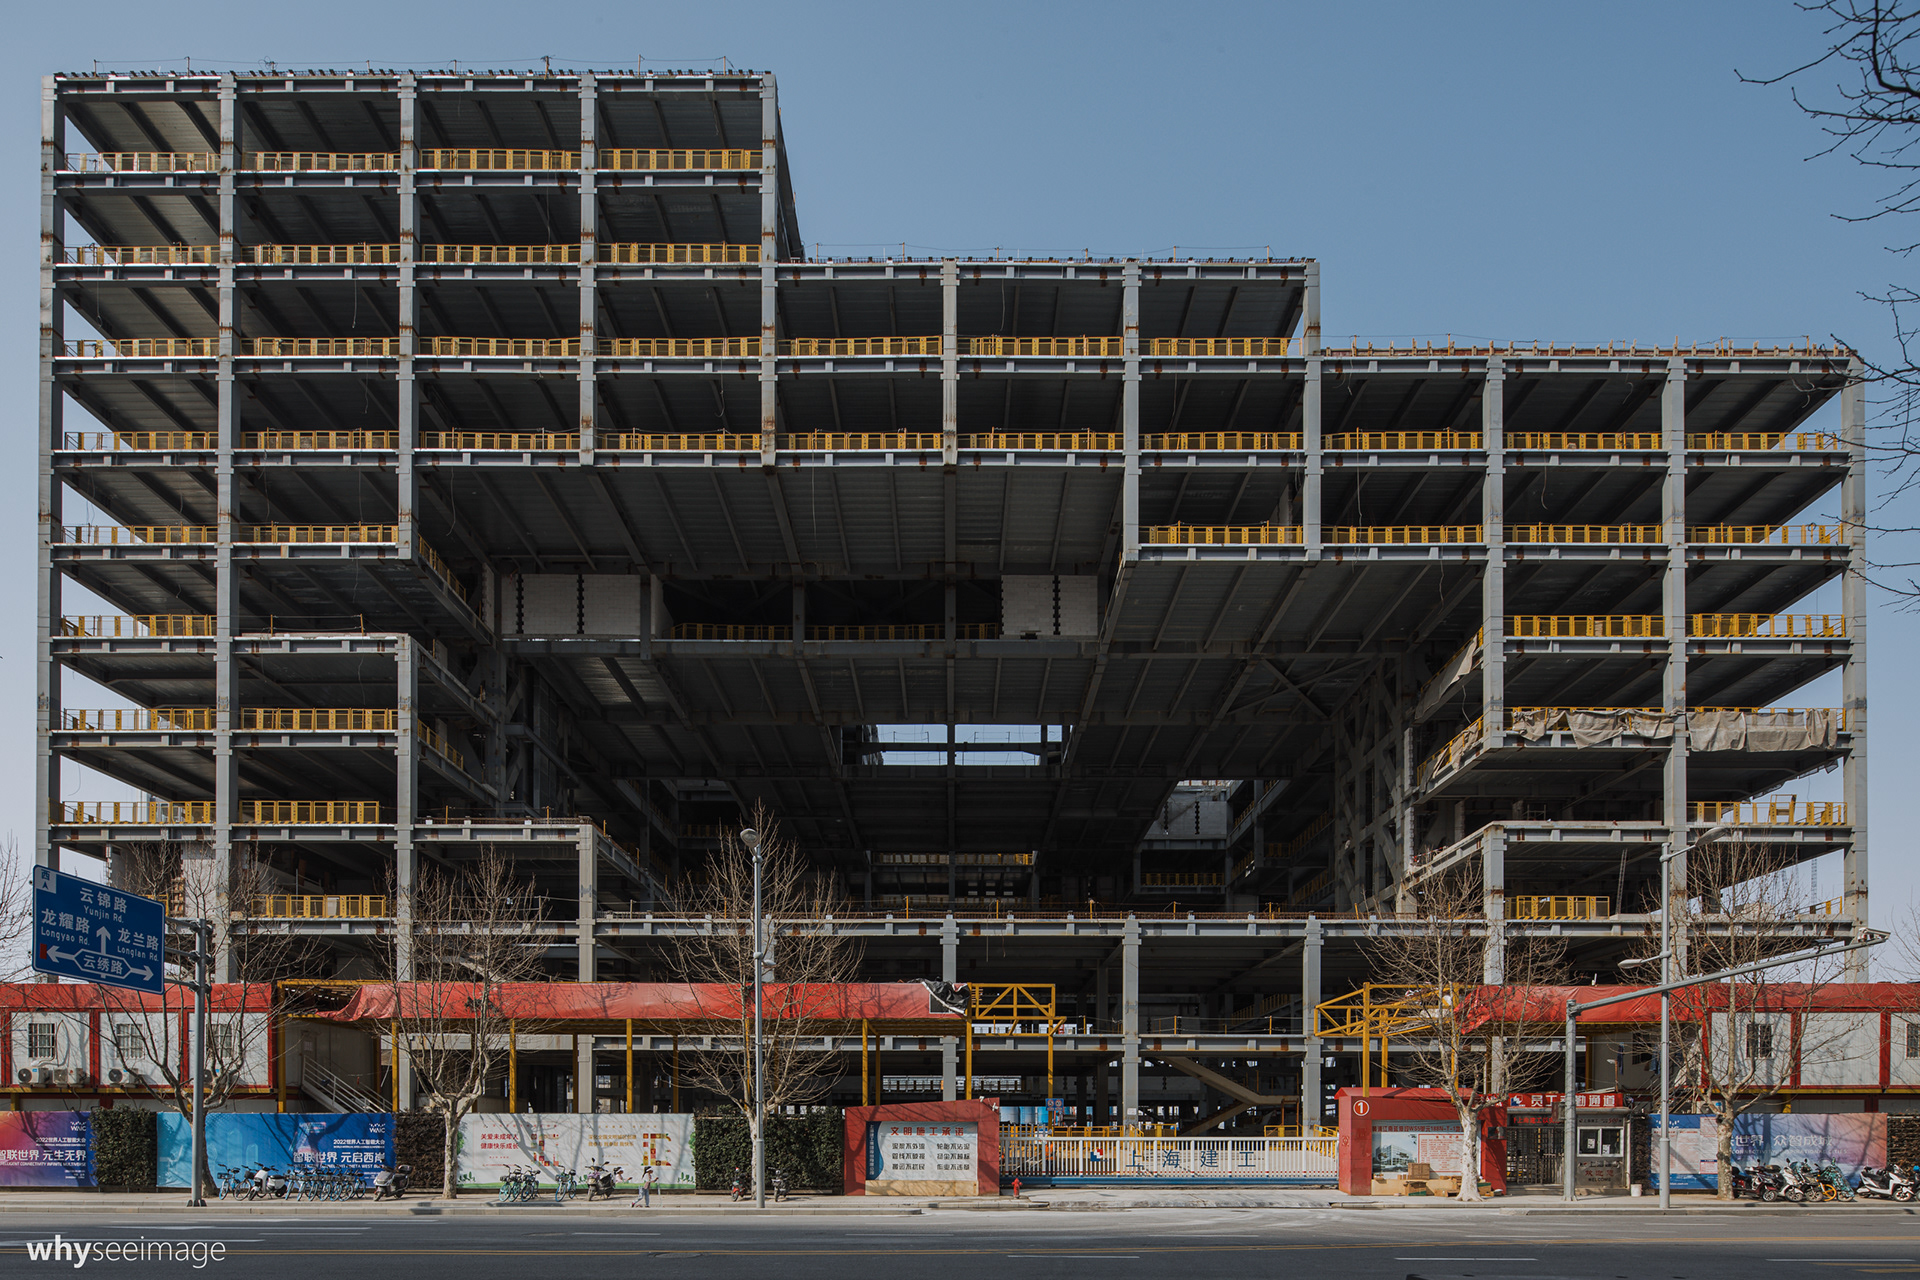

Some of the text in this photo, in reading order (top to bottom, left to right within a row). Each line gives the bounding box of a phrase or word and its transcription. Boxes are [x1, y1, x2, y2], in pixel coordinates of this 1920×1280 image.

[41, 869, 50, 881] 西
[80, 887, 127, 914] 云锦路
[41, 908, 90, 934] 龙耀路
[83, 905, 124, 923] Yunjin Rd.
[41, 926, 90, 945] Longyao Rd.
[118, 928, 159, 951] 龙兰路
[117, 946, 159, 962] Longlan Rd.
[83, 954, 123, 975] 云绣路
[890, 1126, 964, 1136] 文明施工承诺
[1773, 1134, 1833, 1147] 众智成城
[0, 1149, 86, 1161] 智联世界 元生无界
[293, 1151, 385, 1163] 智联世界 元启西岸
[1126, 1149, 1256, 1169] 上海建工
[1585, 1169, 1614, 1177] 欢迎您
